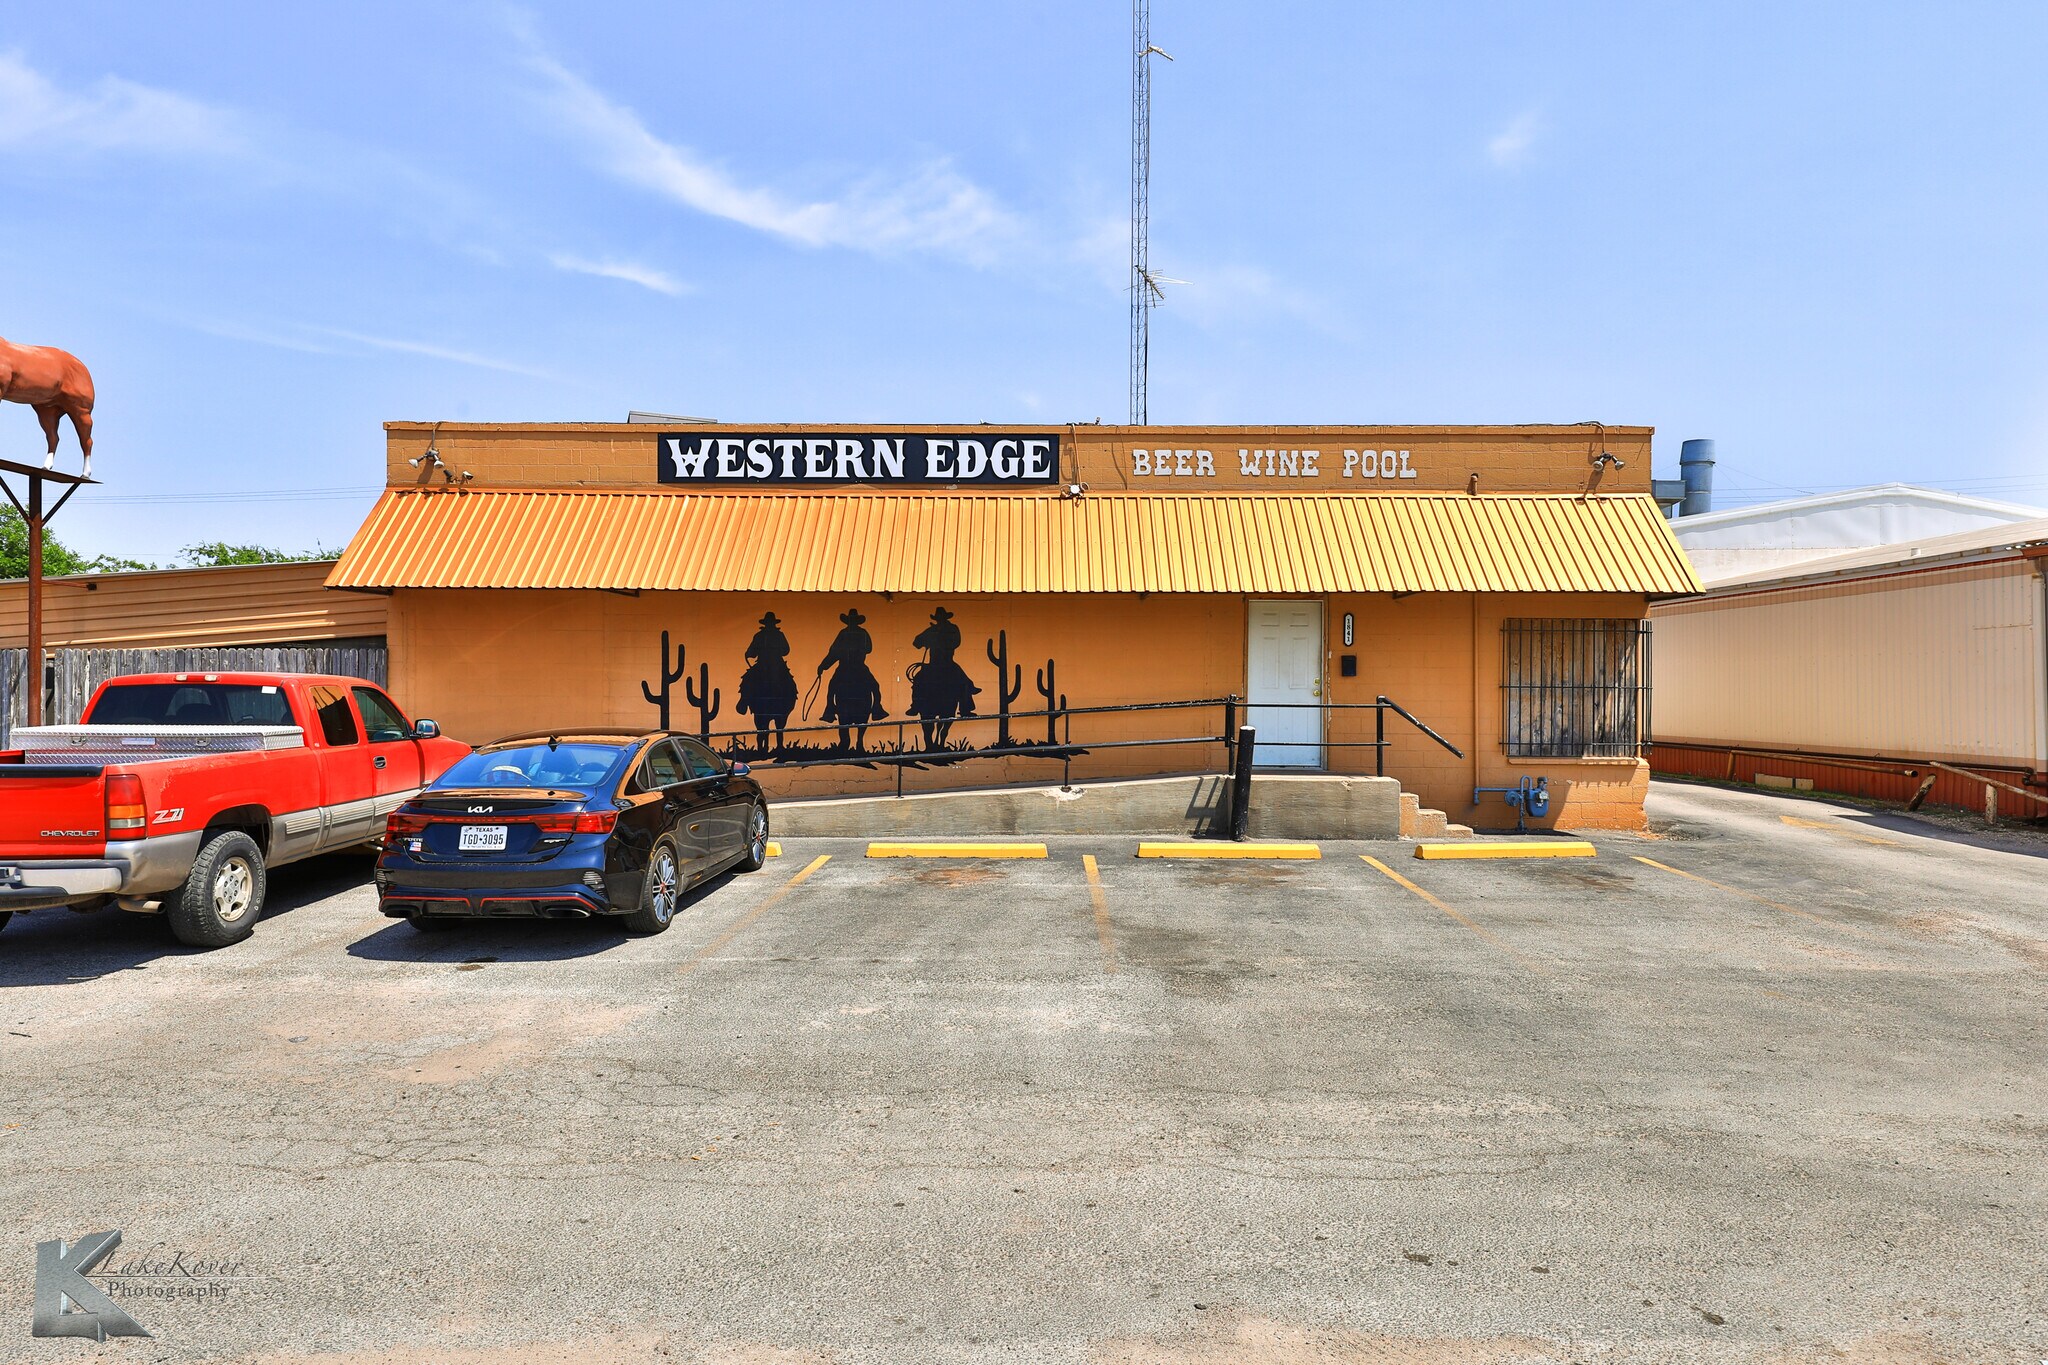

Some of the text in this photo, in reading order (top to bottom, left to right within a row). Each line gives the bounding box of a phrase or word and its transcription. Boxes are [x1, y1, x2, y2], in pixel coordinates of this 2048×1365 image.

[665, 438, 1051, 479] WESTERN EDGE
[1132, 449, 1417, 478] BEER WINE POOL
[152, 807, 185, 825] Z71
